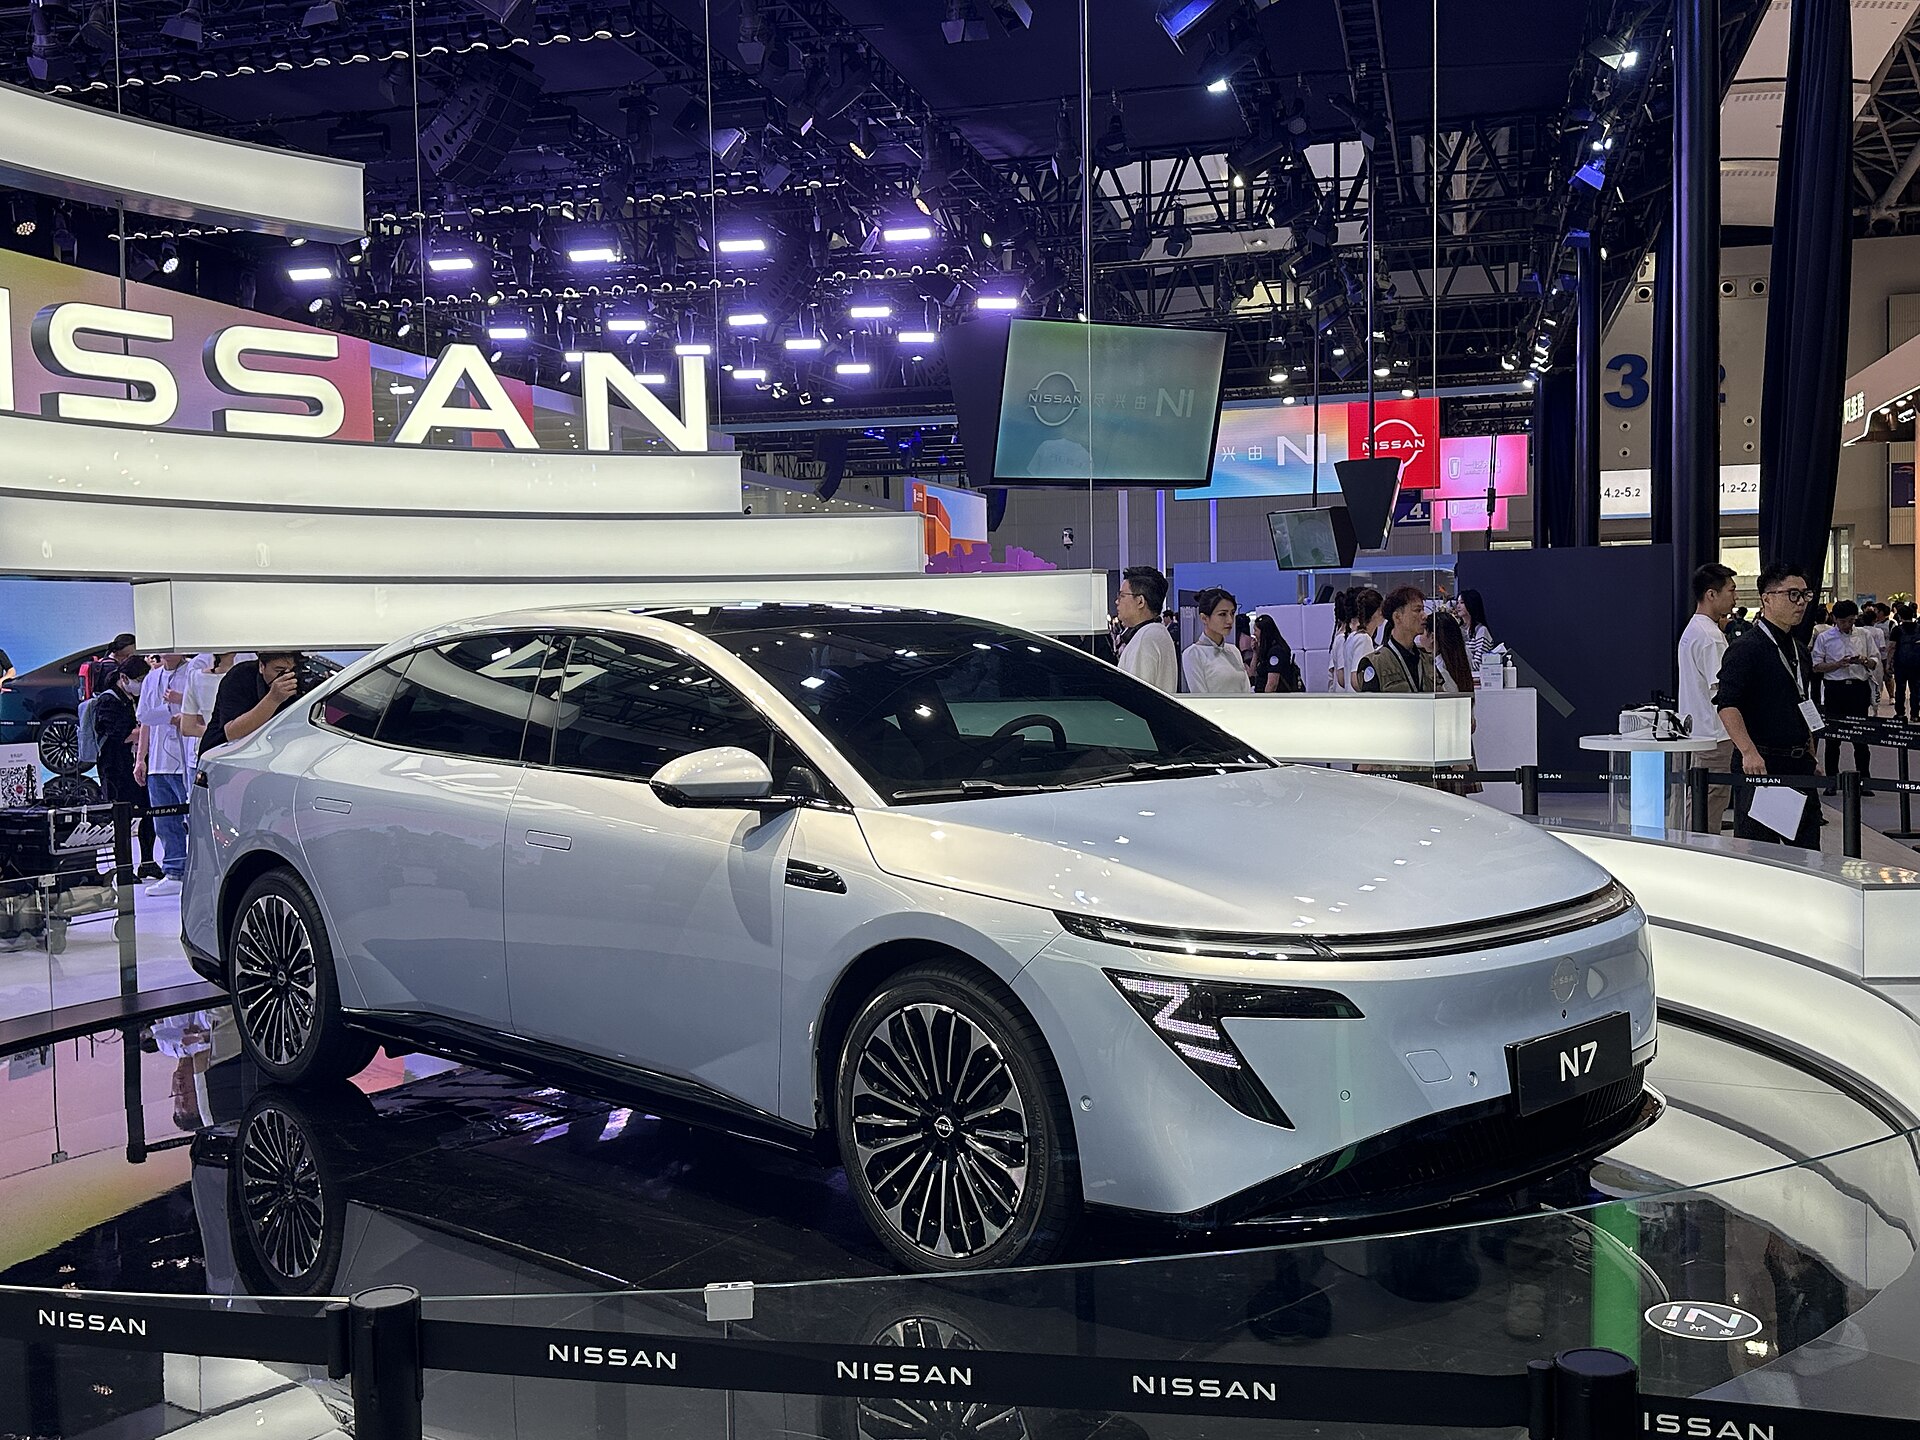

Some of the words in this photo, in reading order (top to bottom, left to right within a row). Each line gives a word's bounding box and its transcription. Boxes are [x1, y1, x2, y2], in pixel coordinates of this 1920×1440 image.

[1604, 353, 1650, 409] 3
[1028, 393, 1082, 405] NISSAN
[1604, 487, 1641, 498] 4.2-5.2
[1720, 482, 1757, 493] 1.2-2.2
[1745, 776, 1781, 784] NISSAN
[146, 807, 178, 815] NISSAN
[1560, 1040, 1598, 1082] N7
[38, 1309, 147, 1336] NISSAN
[549, 1343, 678, 1370] NISSAN
[836, 1361, 973, 1386] NISSAN
[1132, 1375, 1278, 1401] NISSAN
[1644, 1412, 1774, 1440] ISSAN
